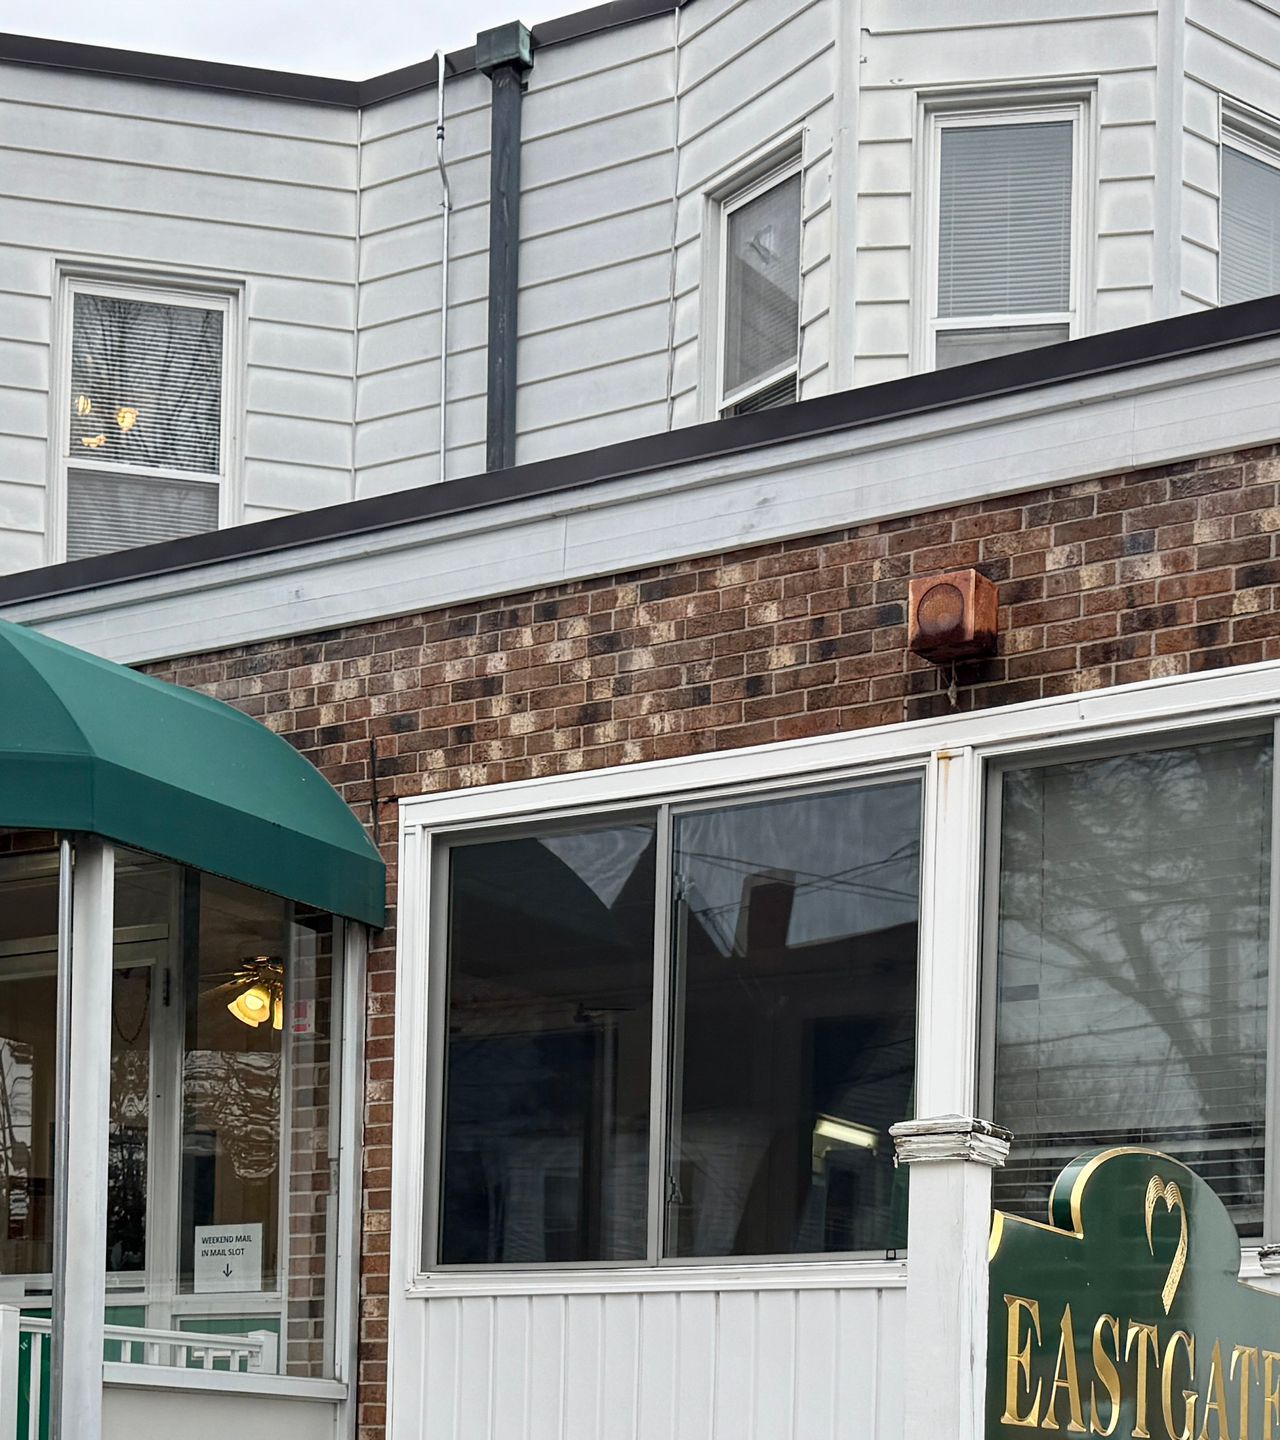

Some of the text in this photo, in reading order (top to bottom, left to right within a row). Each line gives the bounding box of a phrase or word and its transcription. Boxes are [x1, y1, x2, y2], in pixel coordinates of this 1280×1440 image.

[202, 1235, 252, 1244] WEEKEND MAIL
[228, 1248, 245, 1256] SLOT
